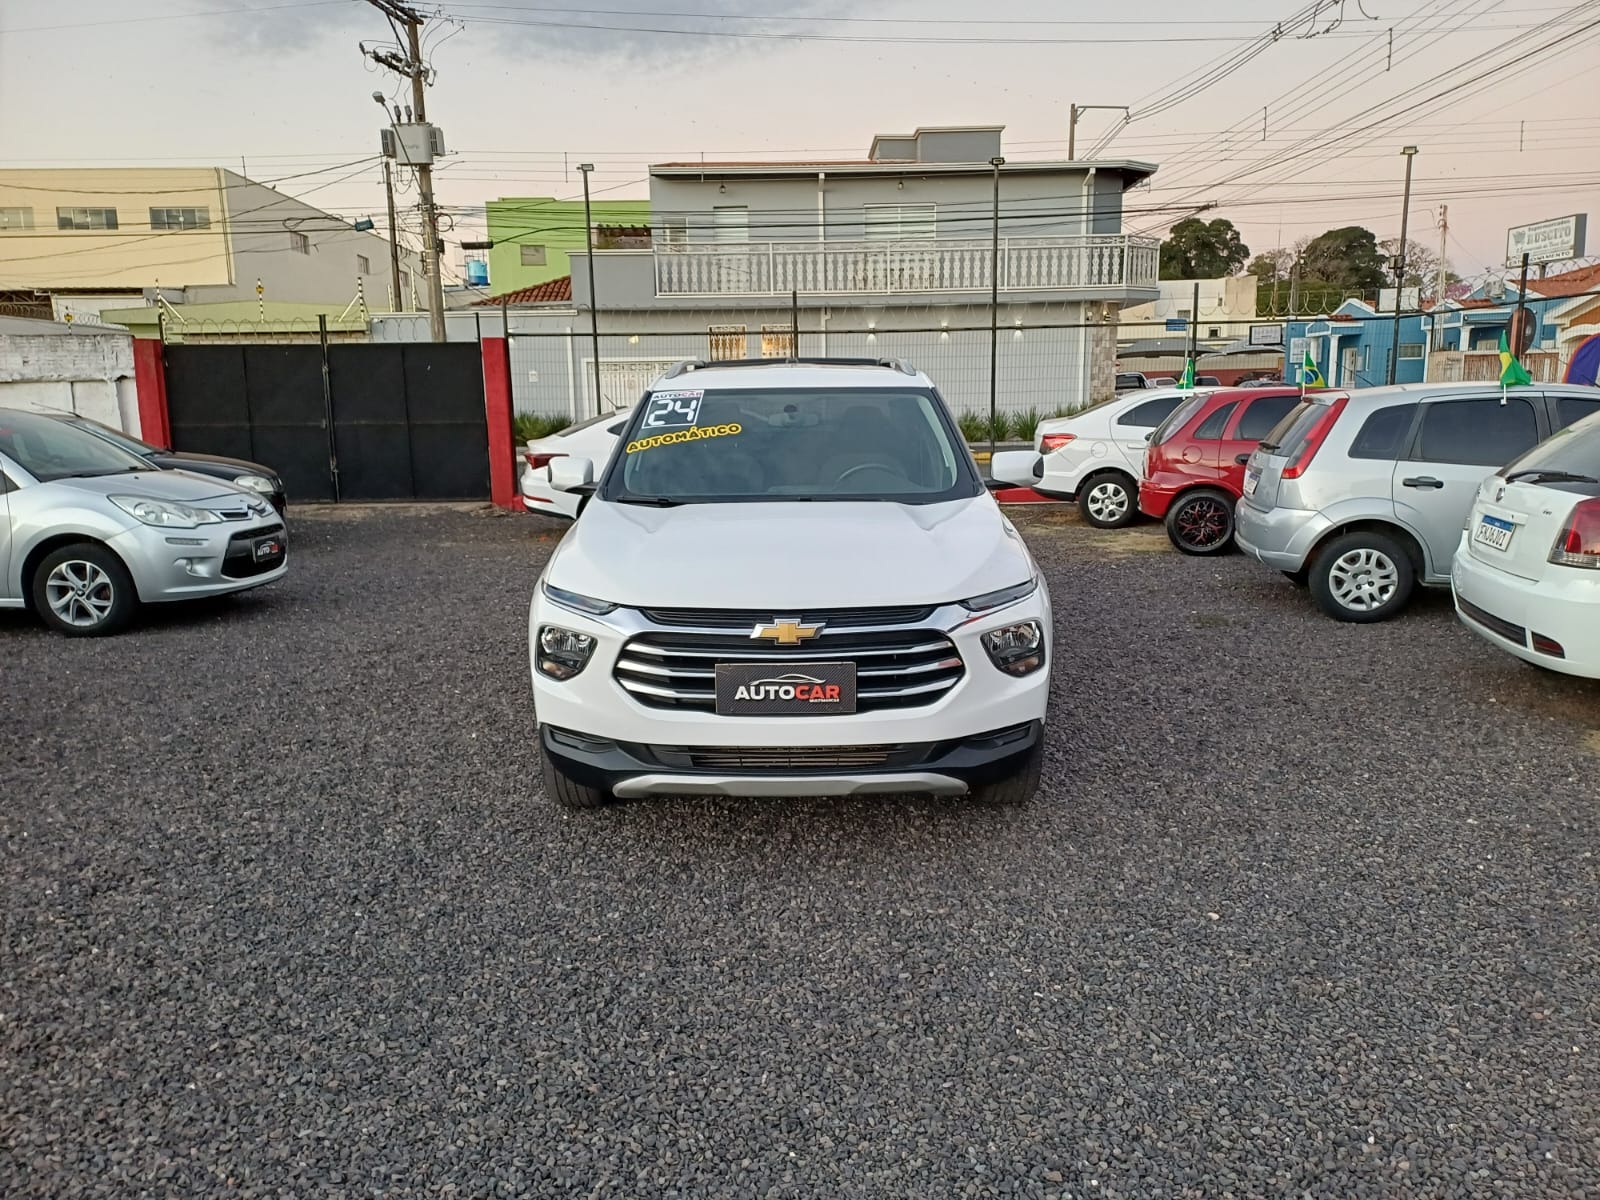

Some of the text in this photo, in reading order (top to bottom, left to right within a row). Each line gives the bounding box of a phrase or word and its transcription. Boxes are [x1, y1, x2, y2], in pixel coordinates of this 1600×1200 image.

[648, 399, 697, 426] 24
[627, 423, 741, 453] AUTOMÁTICO
[734, 685, 840, 700] AUTOCAR
